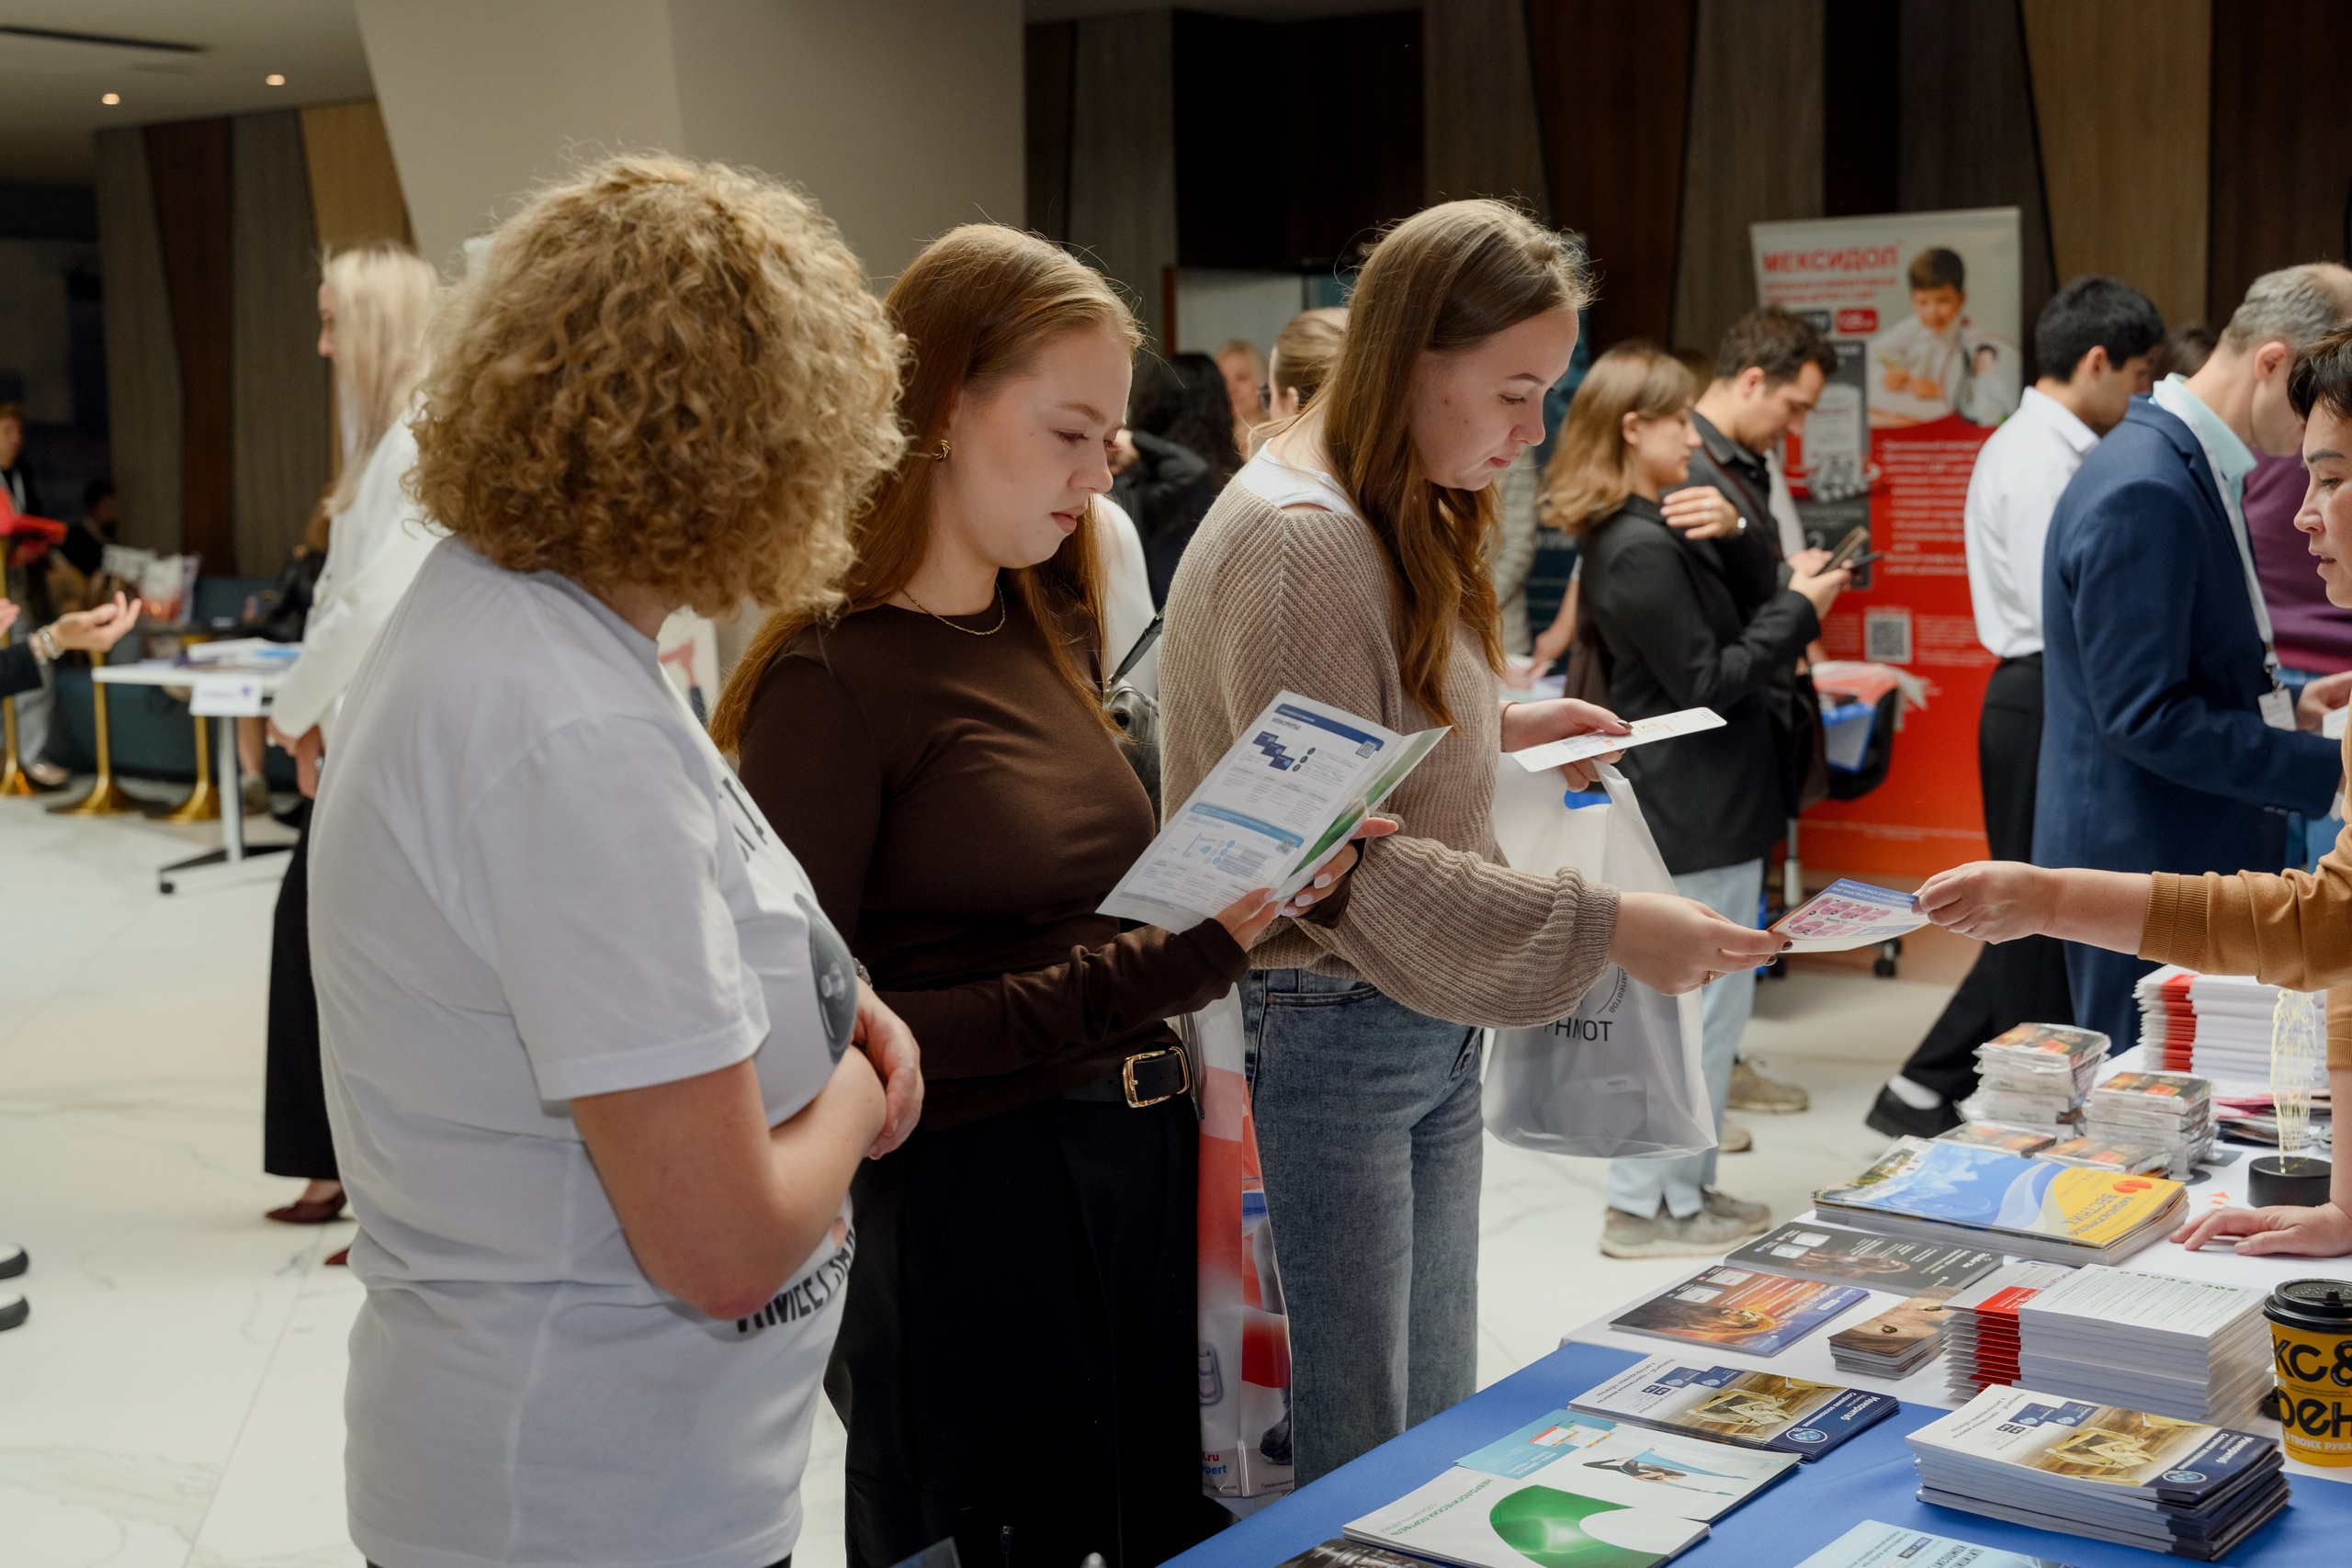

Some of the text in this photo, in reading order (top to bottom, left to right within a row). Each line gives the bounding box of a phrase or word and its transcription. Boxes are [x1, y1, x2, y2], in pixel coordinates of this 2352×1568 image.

[1763, 245, 1898, 273] МЕКСИДОЛ
[1801, 1392, 1858, 1427] Сохраняя воспоминания
[1838, 1395, 1881, 1420] Меморитаб
[2176, 1432, 2231, 1470] Сохраняя воспоминания
[2212, 1436, 2255, 1464] Меморитаб
[2290, 1433, 2322, 1449] ТВОИХ
[1388, 1478, 1494, 1535] НЕВРОЛОГИЧЕСКИЙ ПОРТФЕЛЬ
